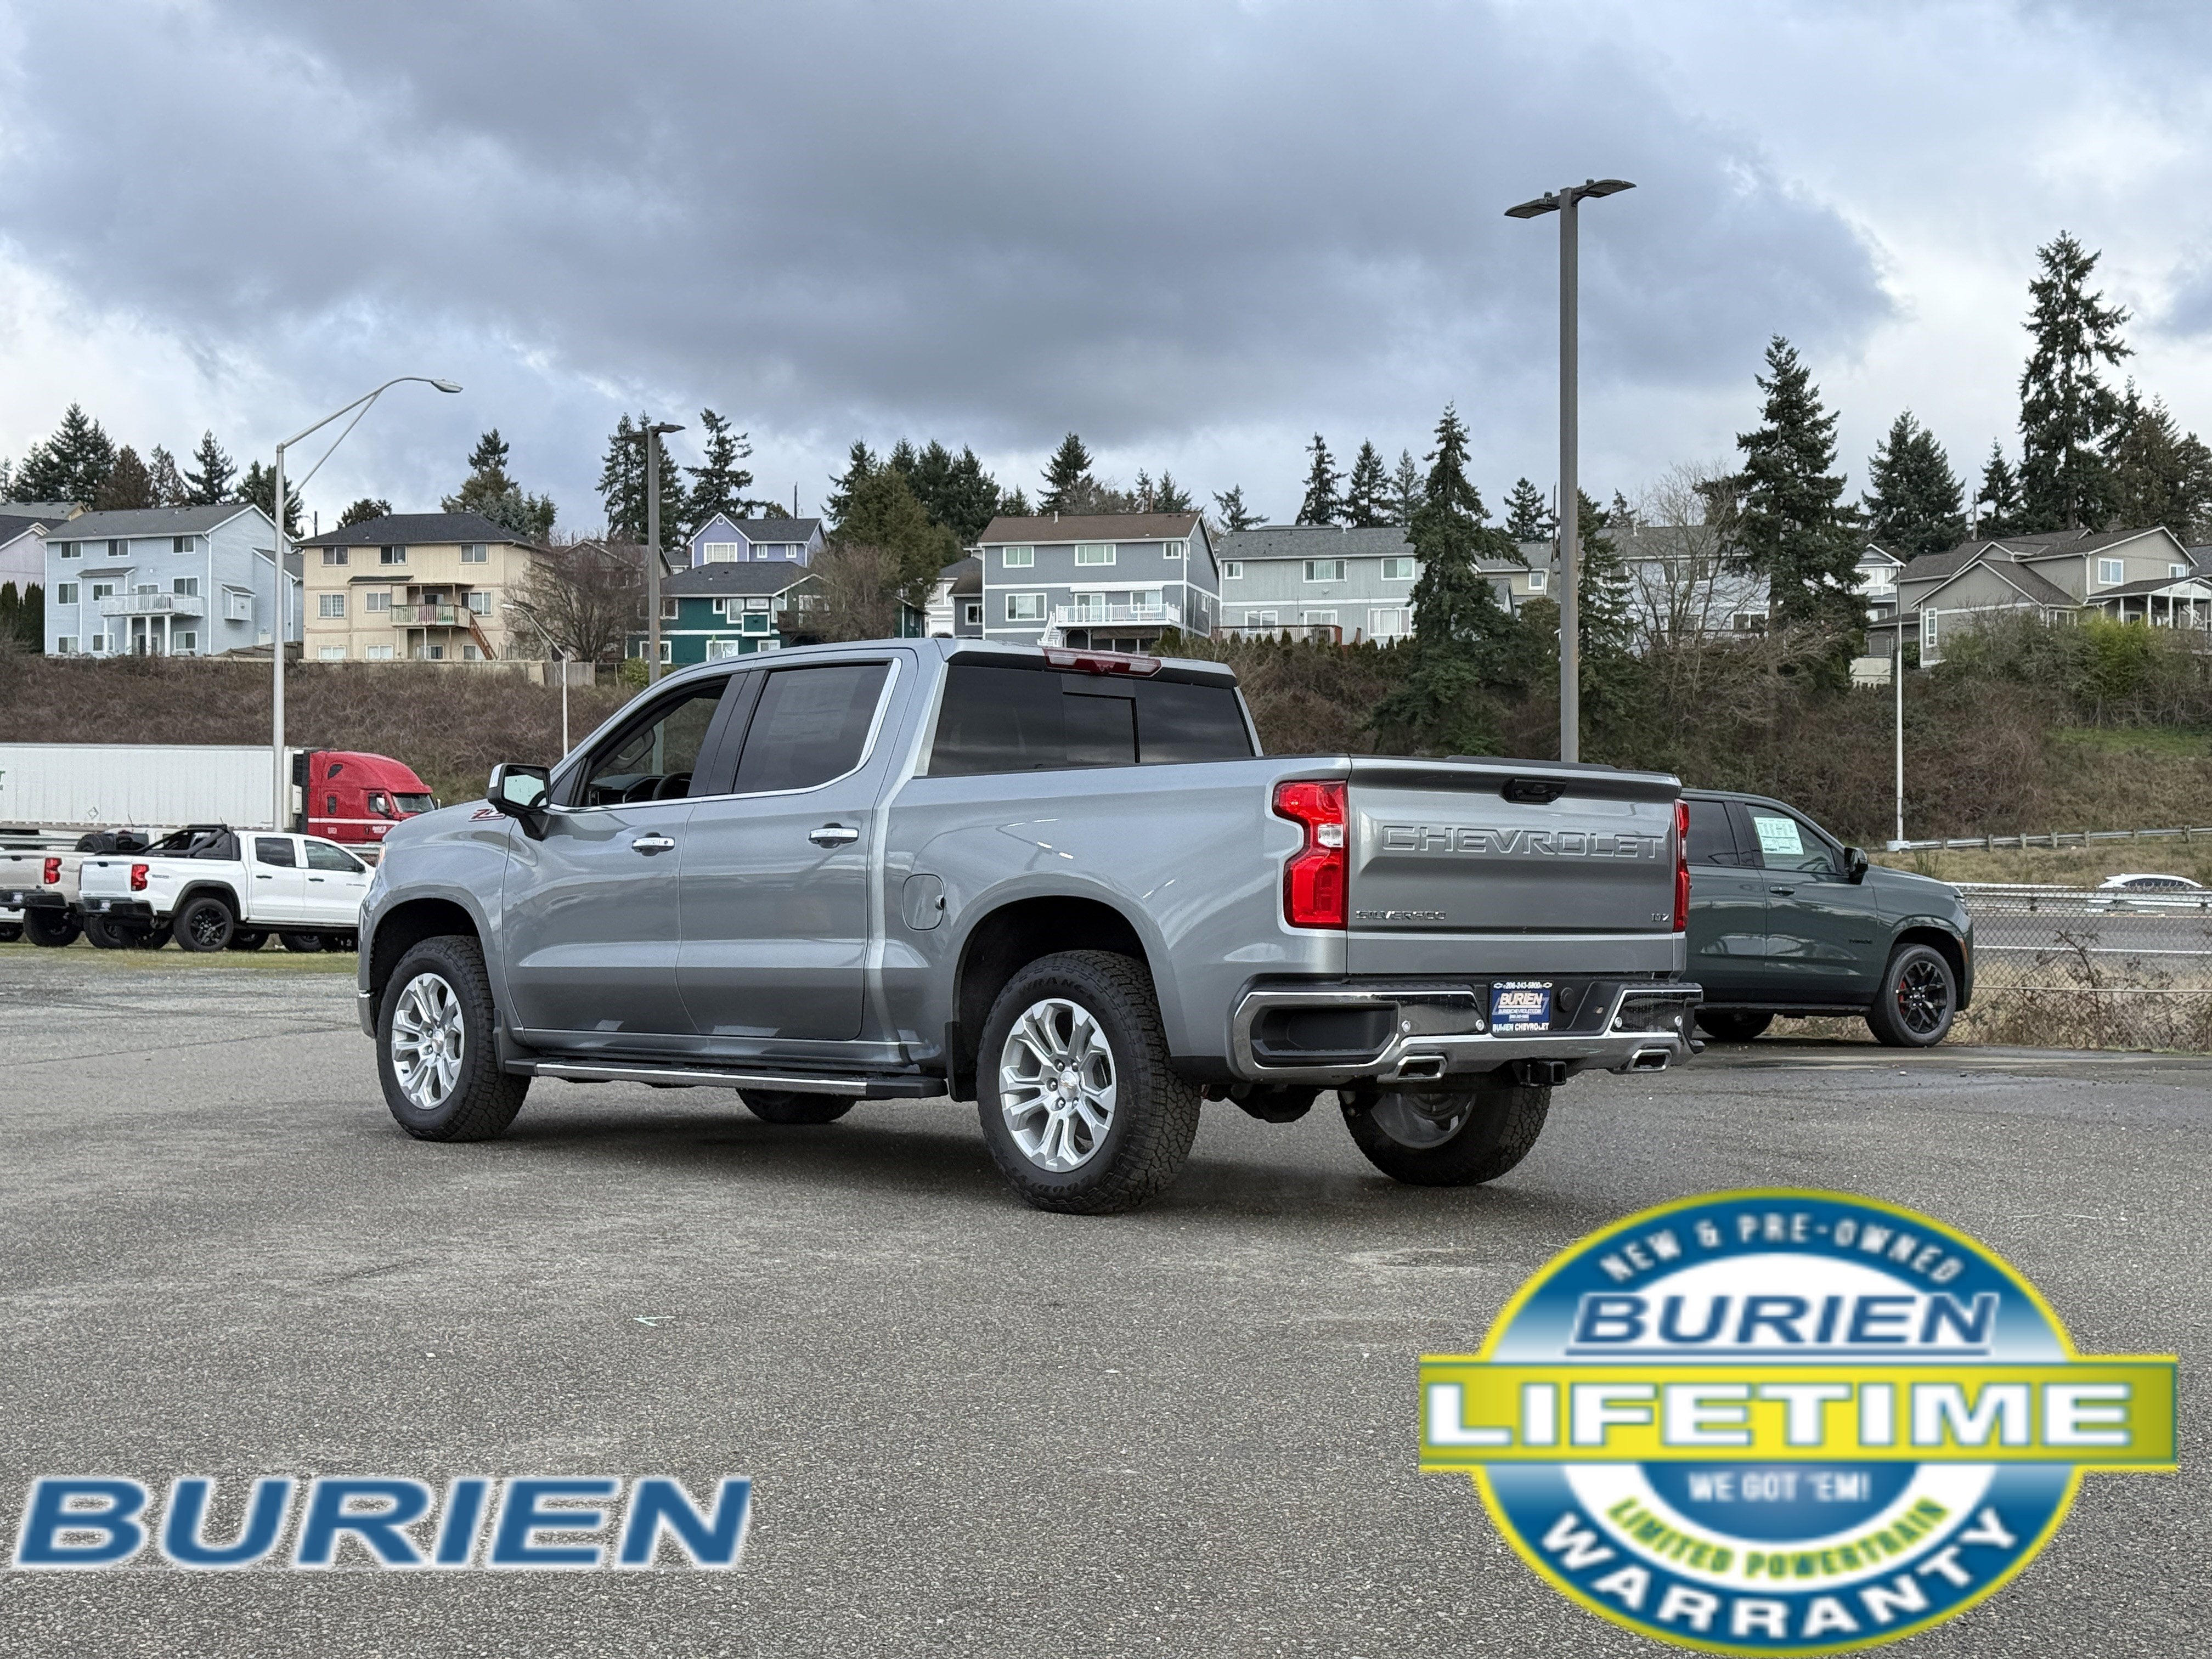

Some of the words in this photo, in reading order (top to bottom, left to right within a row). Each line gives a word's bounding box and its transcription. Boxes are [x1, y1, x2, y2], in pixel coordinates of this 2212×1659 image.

[1383, 826, 1666, 858] CHEVROLET
[1499, 992, 1543, 1005] BURIEN
[1514, 1023, 1550, 1031] CHEVROLET
